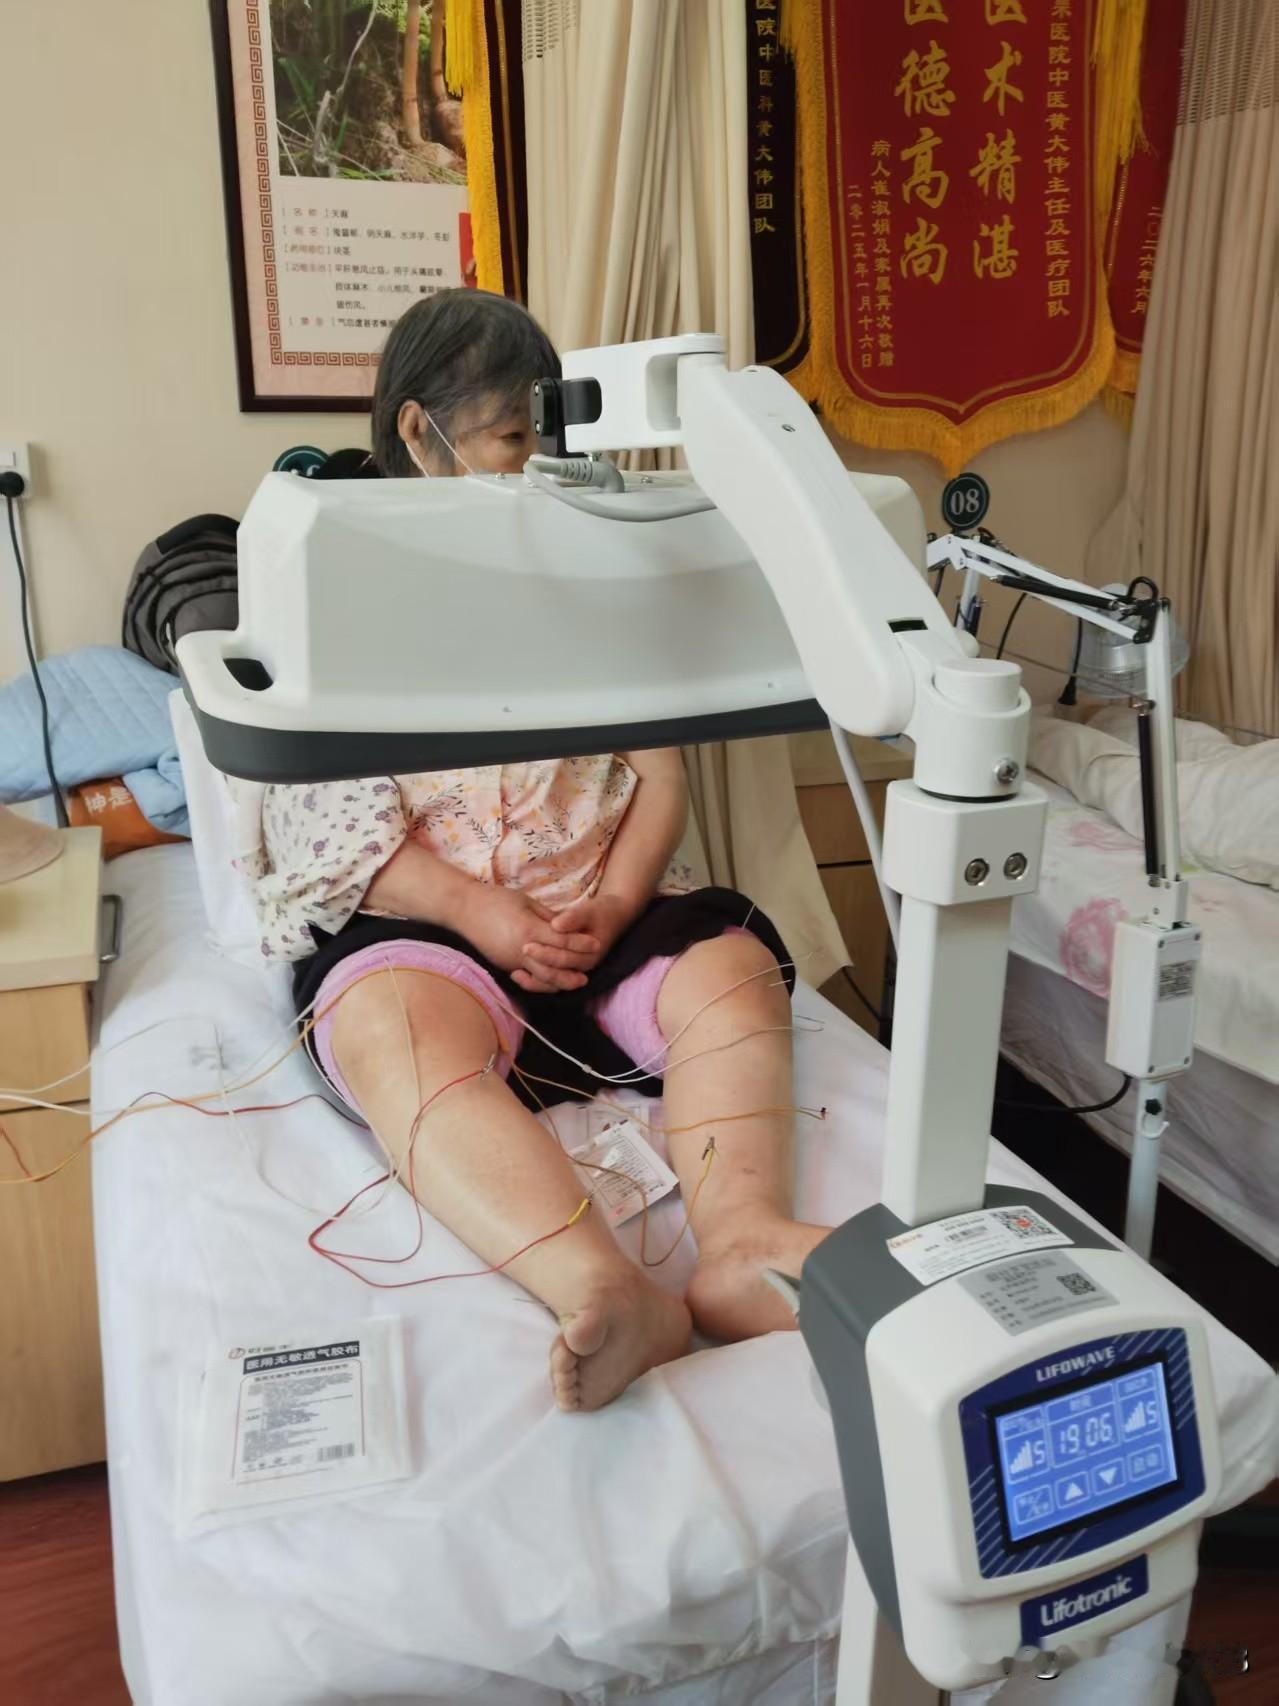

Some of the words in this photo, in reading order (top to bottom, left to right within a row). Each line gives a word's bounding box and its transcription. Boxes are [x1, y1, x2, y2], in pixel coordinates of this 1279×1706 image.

[950, 488, 980, 516] 08
[1035, 1345, 1116, 1382] LIFOWAVE
[1040, 1574, 1134, 1628] Lifotronic
